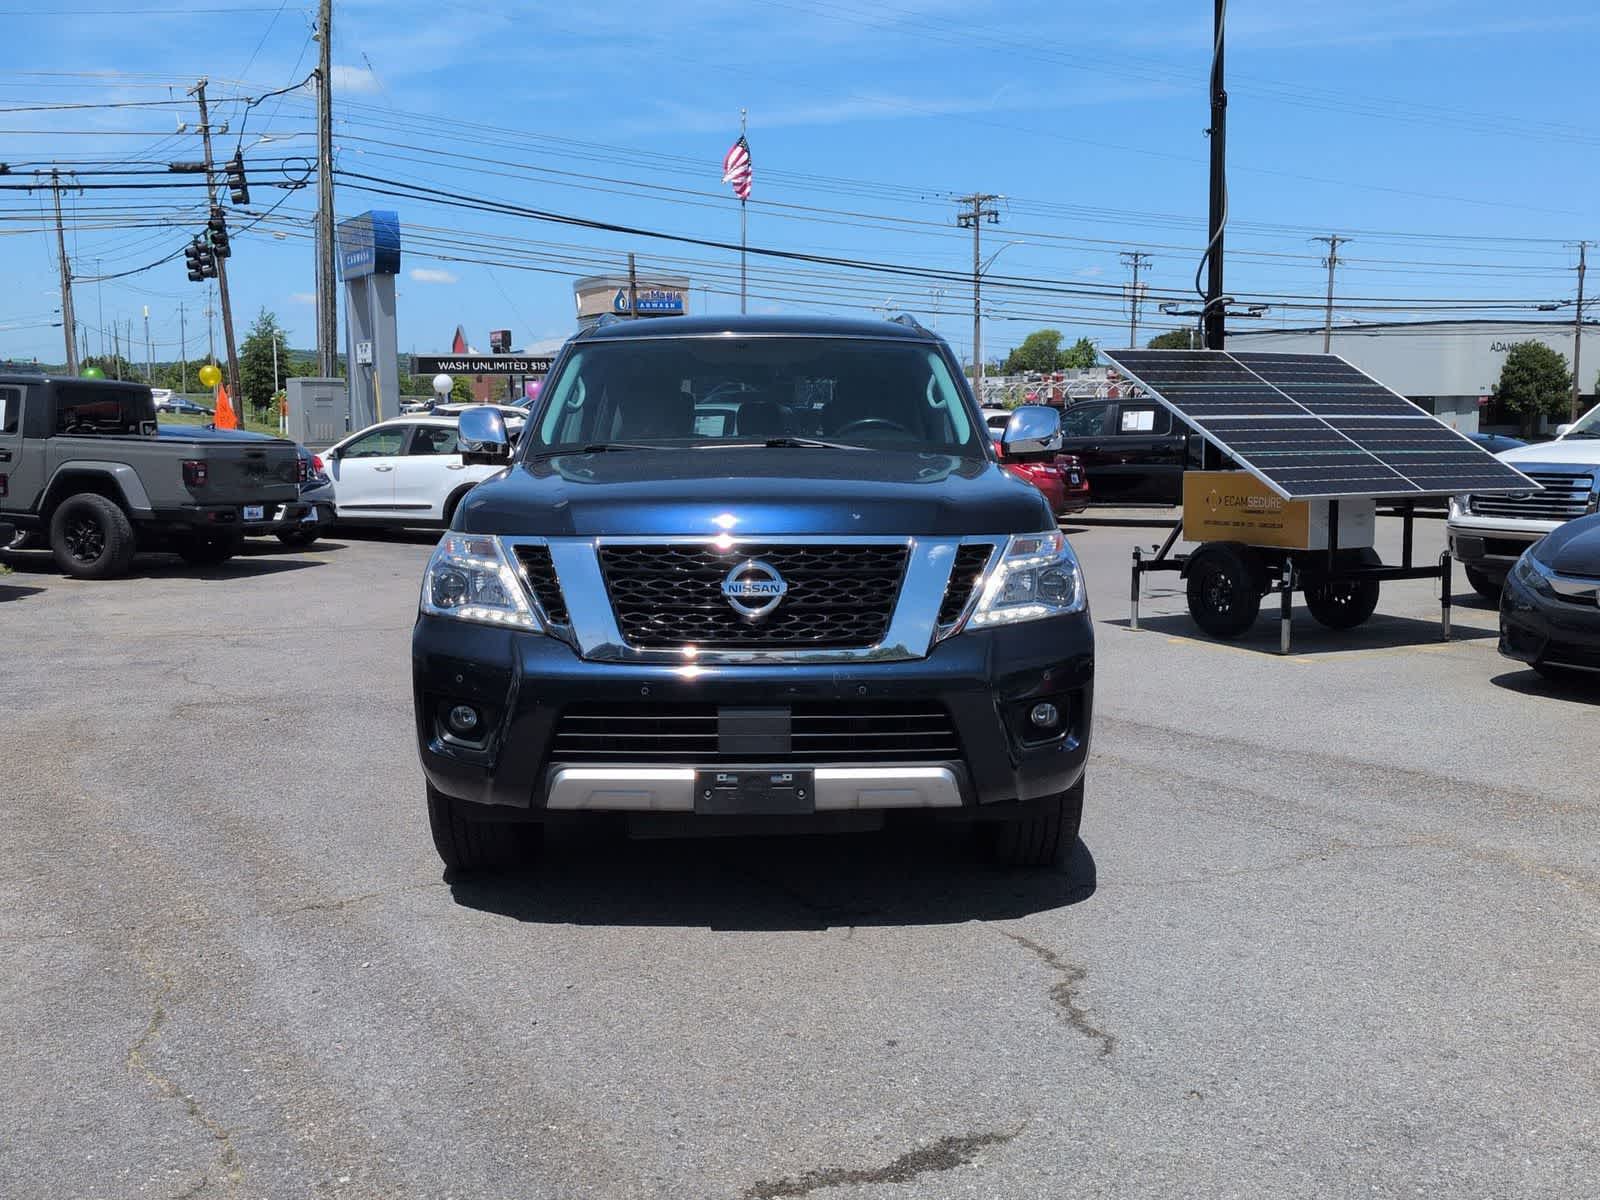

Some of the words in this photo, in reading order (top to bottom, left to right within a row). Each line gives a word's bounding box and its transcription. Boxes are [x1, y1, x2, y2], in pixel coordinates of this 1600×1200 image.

[438, 361, 470, 371] WASH
[472, 361, 528, 371] UNLIMITED
[1224, 495, 1281, 509] ECAMSECURE
[728, 584, 780, 593] NISSAN
